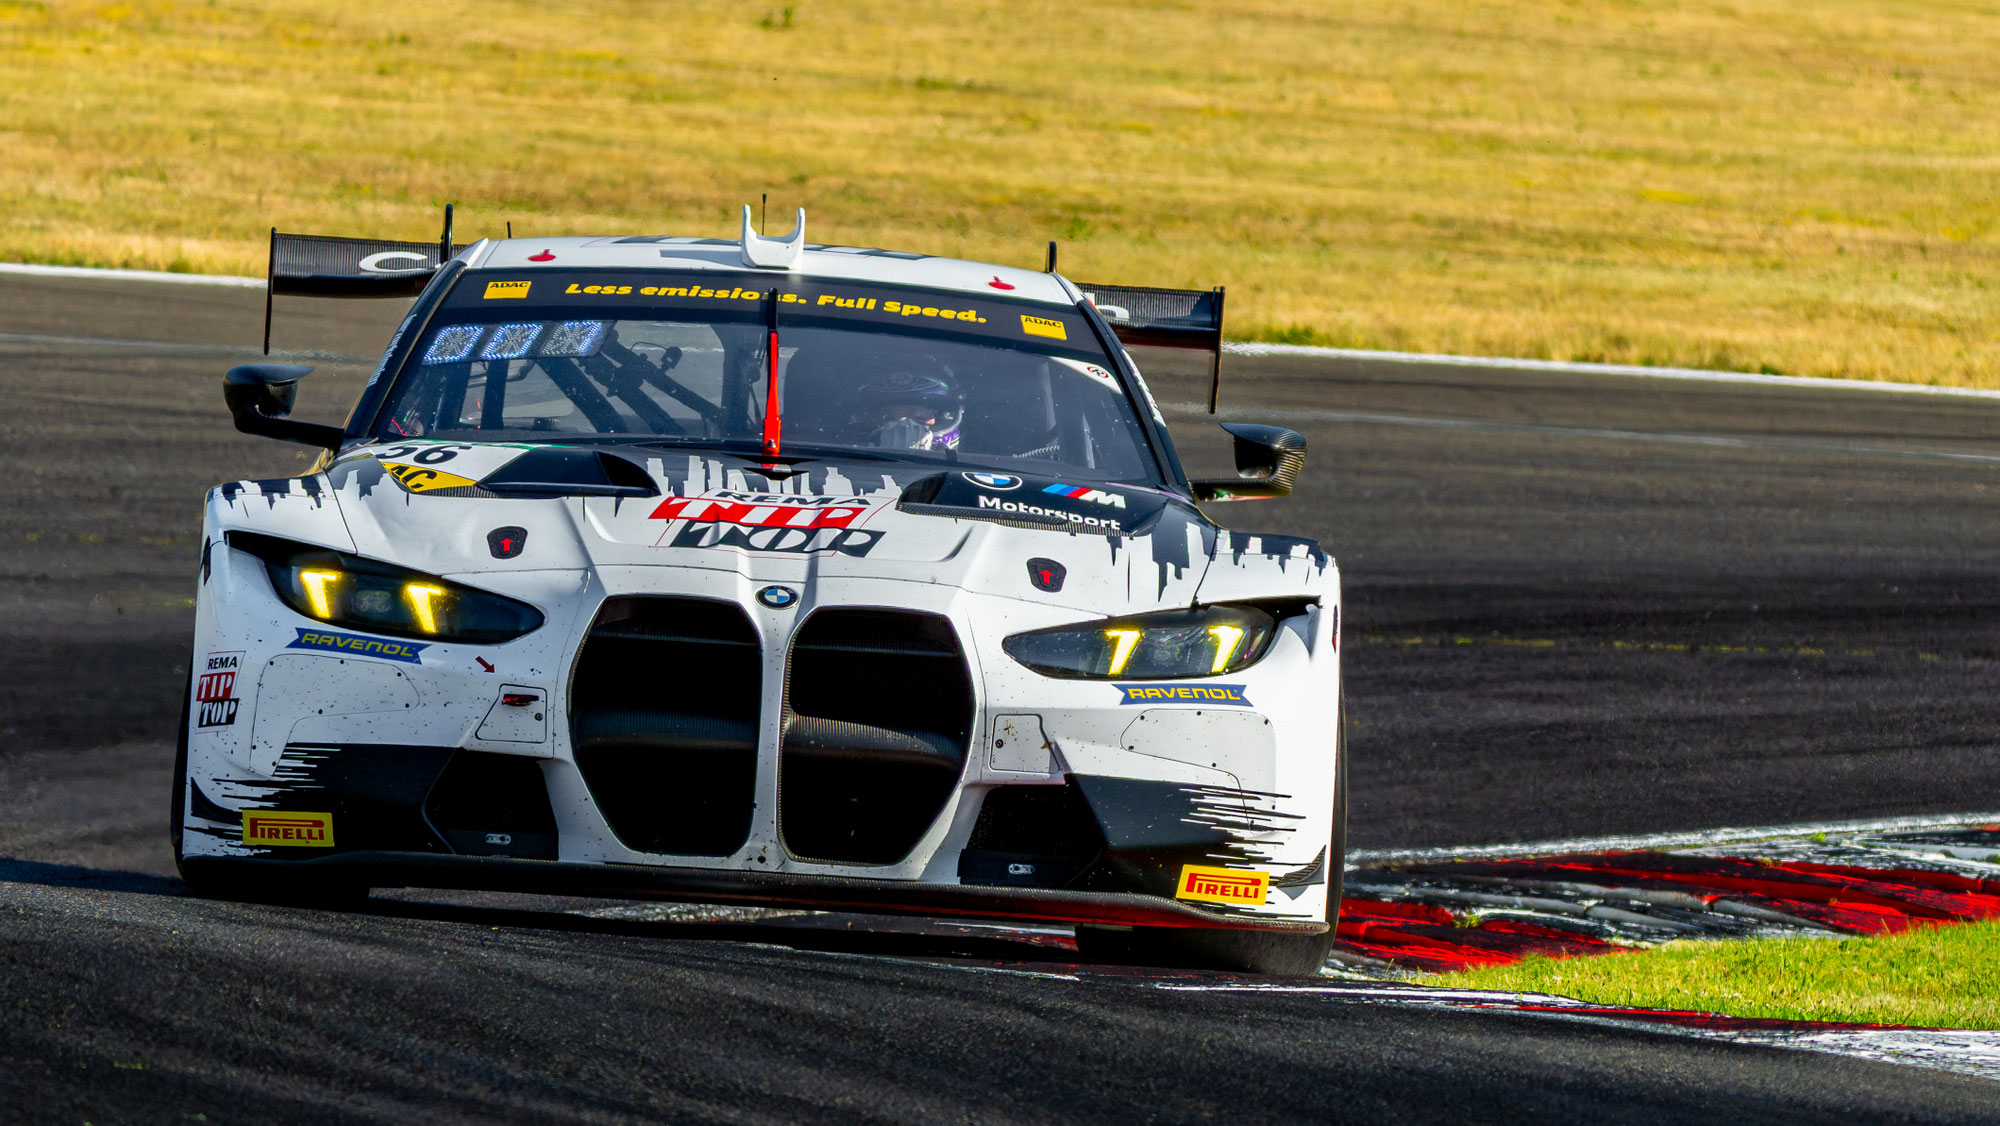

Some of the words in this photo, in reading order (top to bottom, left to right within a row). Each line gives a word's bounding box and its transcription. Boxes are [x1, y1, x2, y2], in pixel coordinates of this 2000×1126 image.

[565, 283, 633, 295] Less
[817, 295, 877, 310] Full
[883, 301, 987, 323] Speed.
[1024, 317, 1062, 328] ADAC
[714, 491, 871, 506] REMA
[669, 497, 854, 528] TIP
[978, 495, 1121, 531] Motorsport
[689, 521, 872, 552] TOP
[301, 633, 414, 657] RAVENOL
[207, 656, 238, 670] REMA
[200, 674, 233, 699] TIP
[1127, 688, 1241, 700] RAVENOL
[202, 700, 236, 726] TOP
[249, 817, 325, 841] PIRELLI
[1185, 872, 1262, 899] PIRELLI
